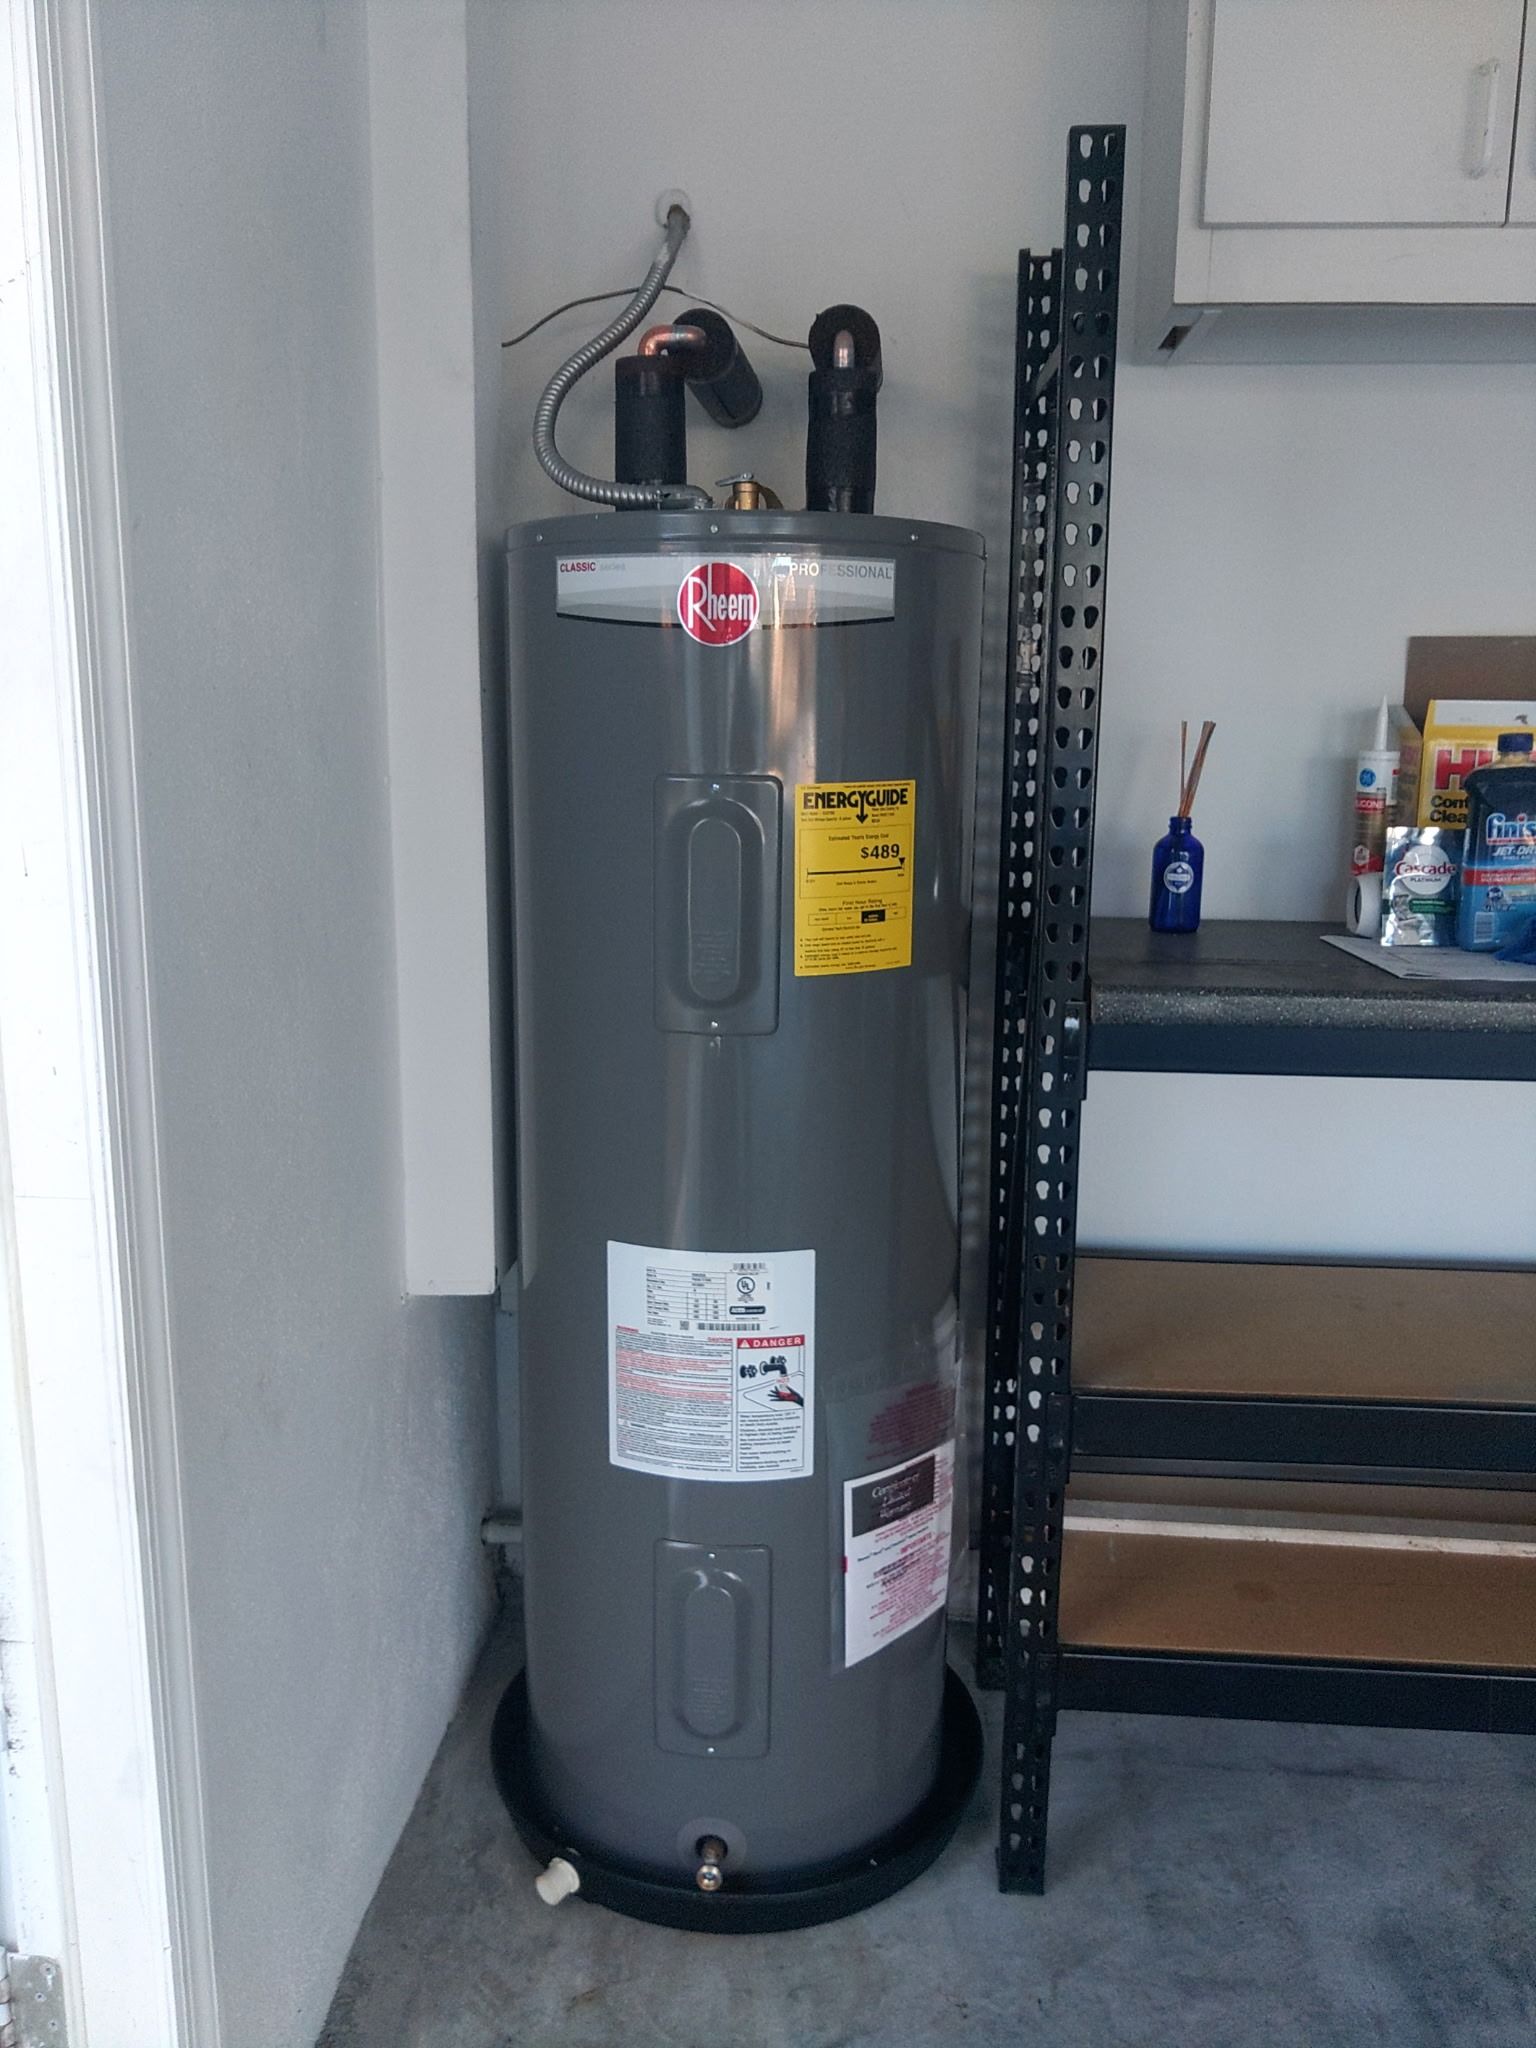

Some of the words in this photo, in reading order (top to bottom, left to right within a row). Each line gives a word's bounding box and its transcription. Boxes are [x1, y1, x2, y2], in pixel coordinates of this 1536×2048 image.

[560, 562, 596, 573] CLASSIC
[687, 563, 754, 632] Rheem
[860, 844, 900, 860] $489
[1396, 861, 1457, 876] Cascade
[753, 1337, 801, 1348] DANGER
